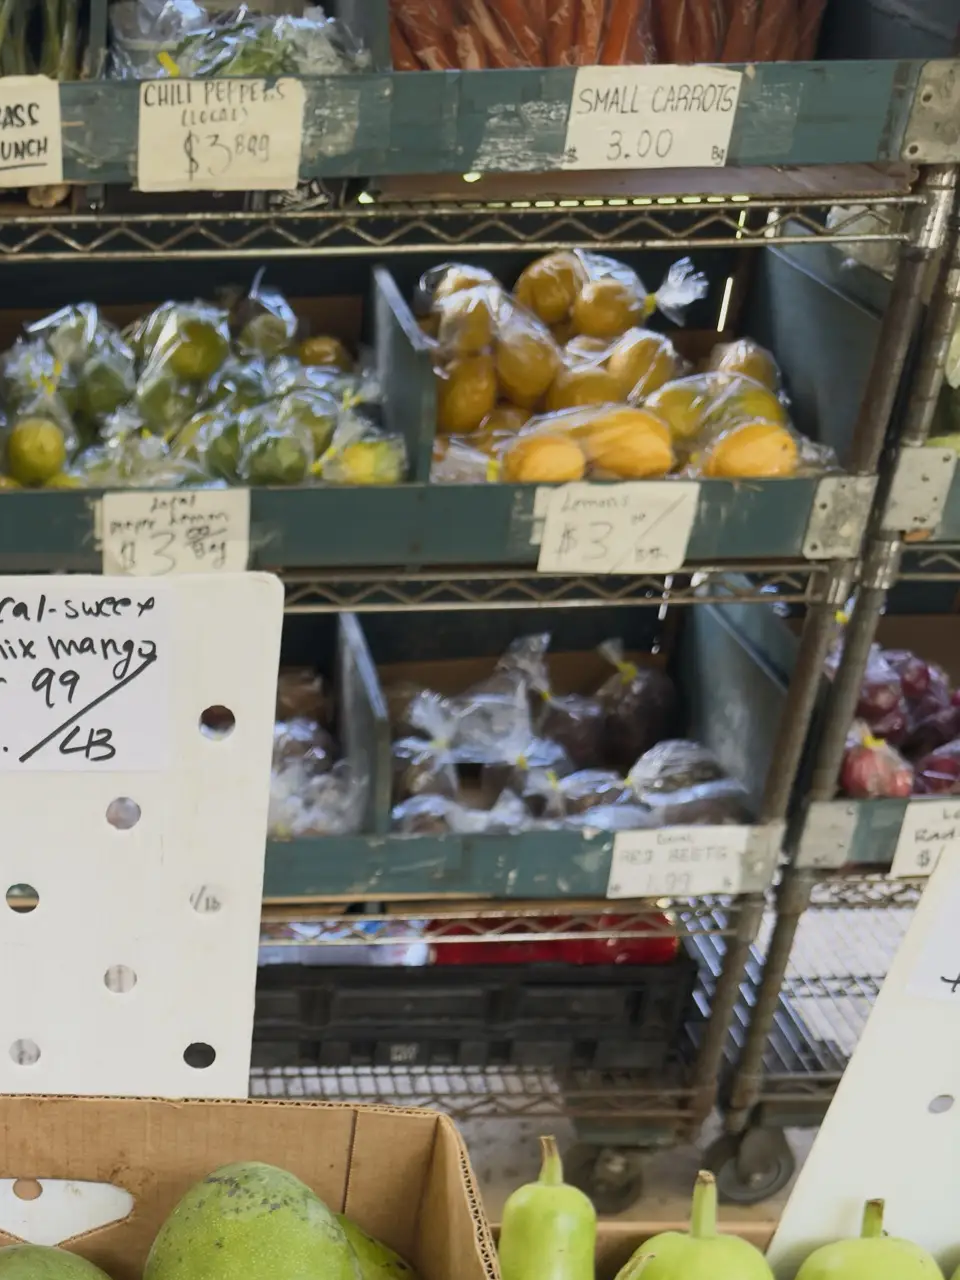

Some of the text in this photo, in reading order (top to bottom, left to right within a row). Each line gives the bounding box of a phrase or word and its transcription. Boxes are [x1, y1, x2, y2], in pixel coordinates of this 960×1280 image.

[144, 81, 285, 106] CHILI PEPPES
[577, 83, 736, 114] SMALL CARROTS
[607, 129, 673, 161] 3.00
[47, 635, 157, 680] mango
